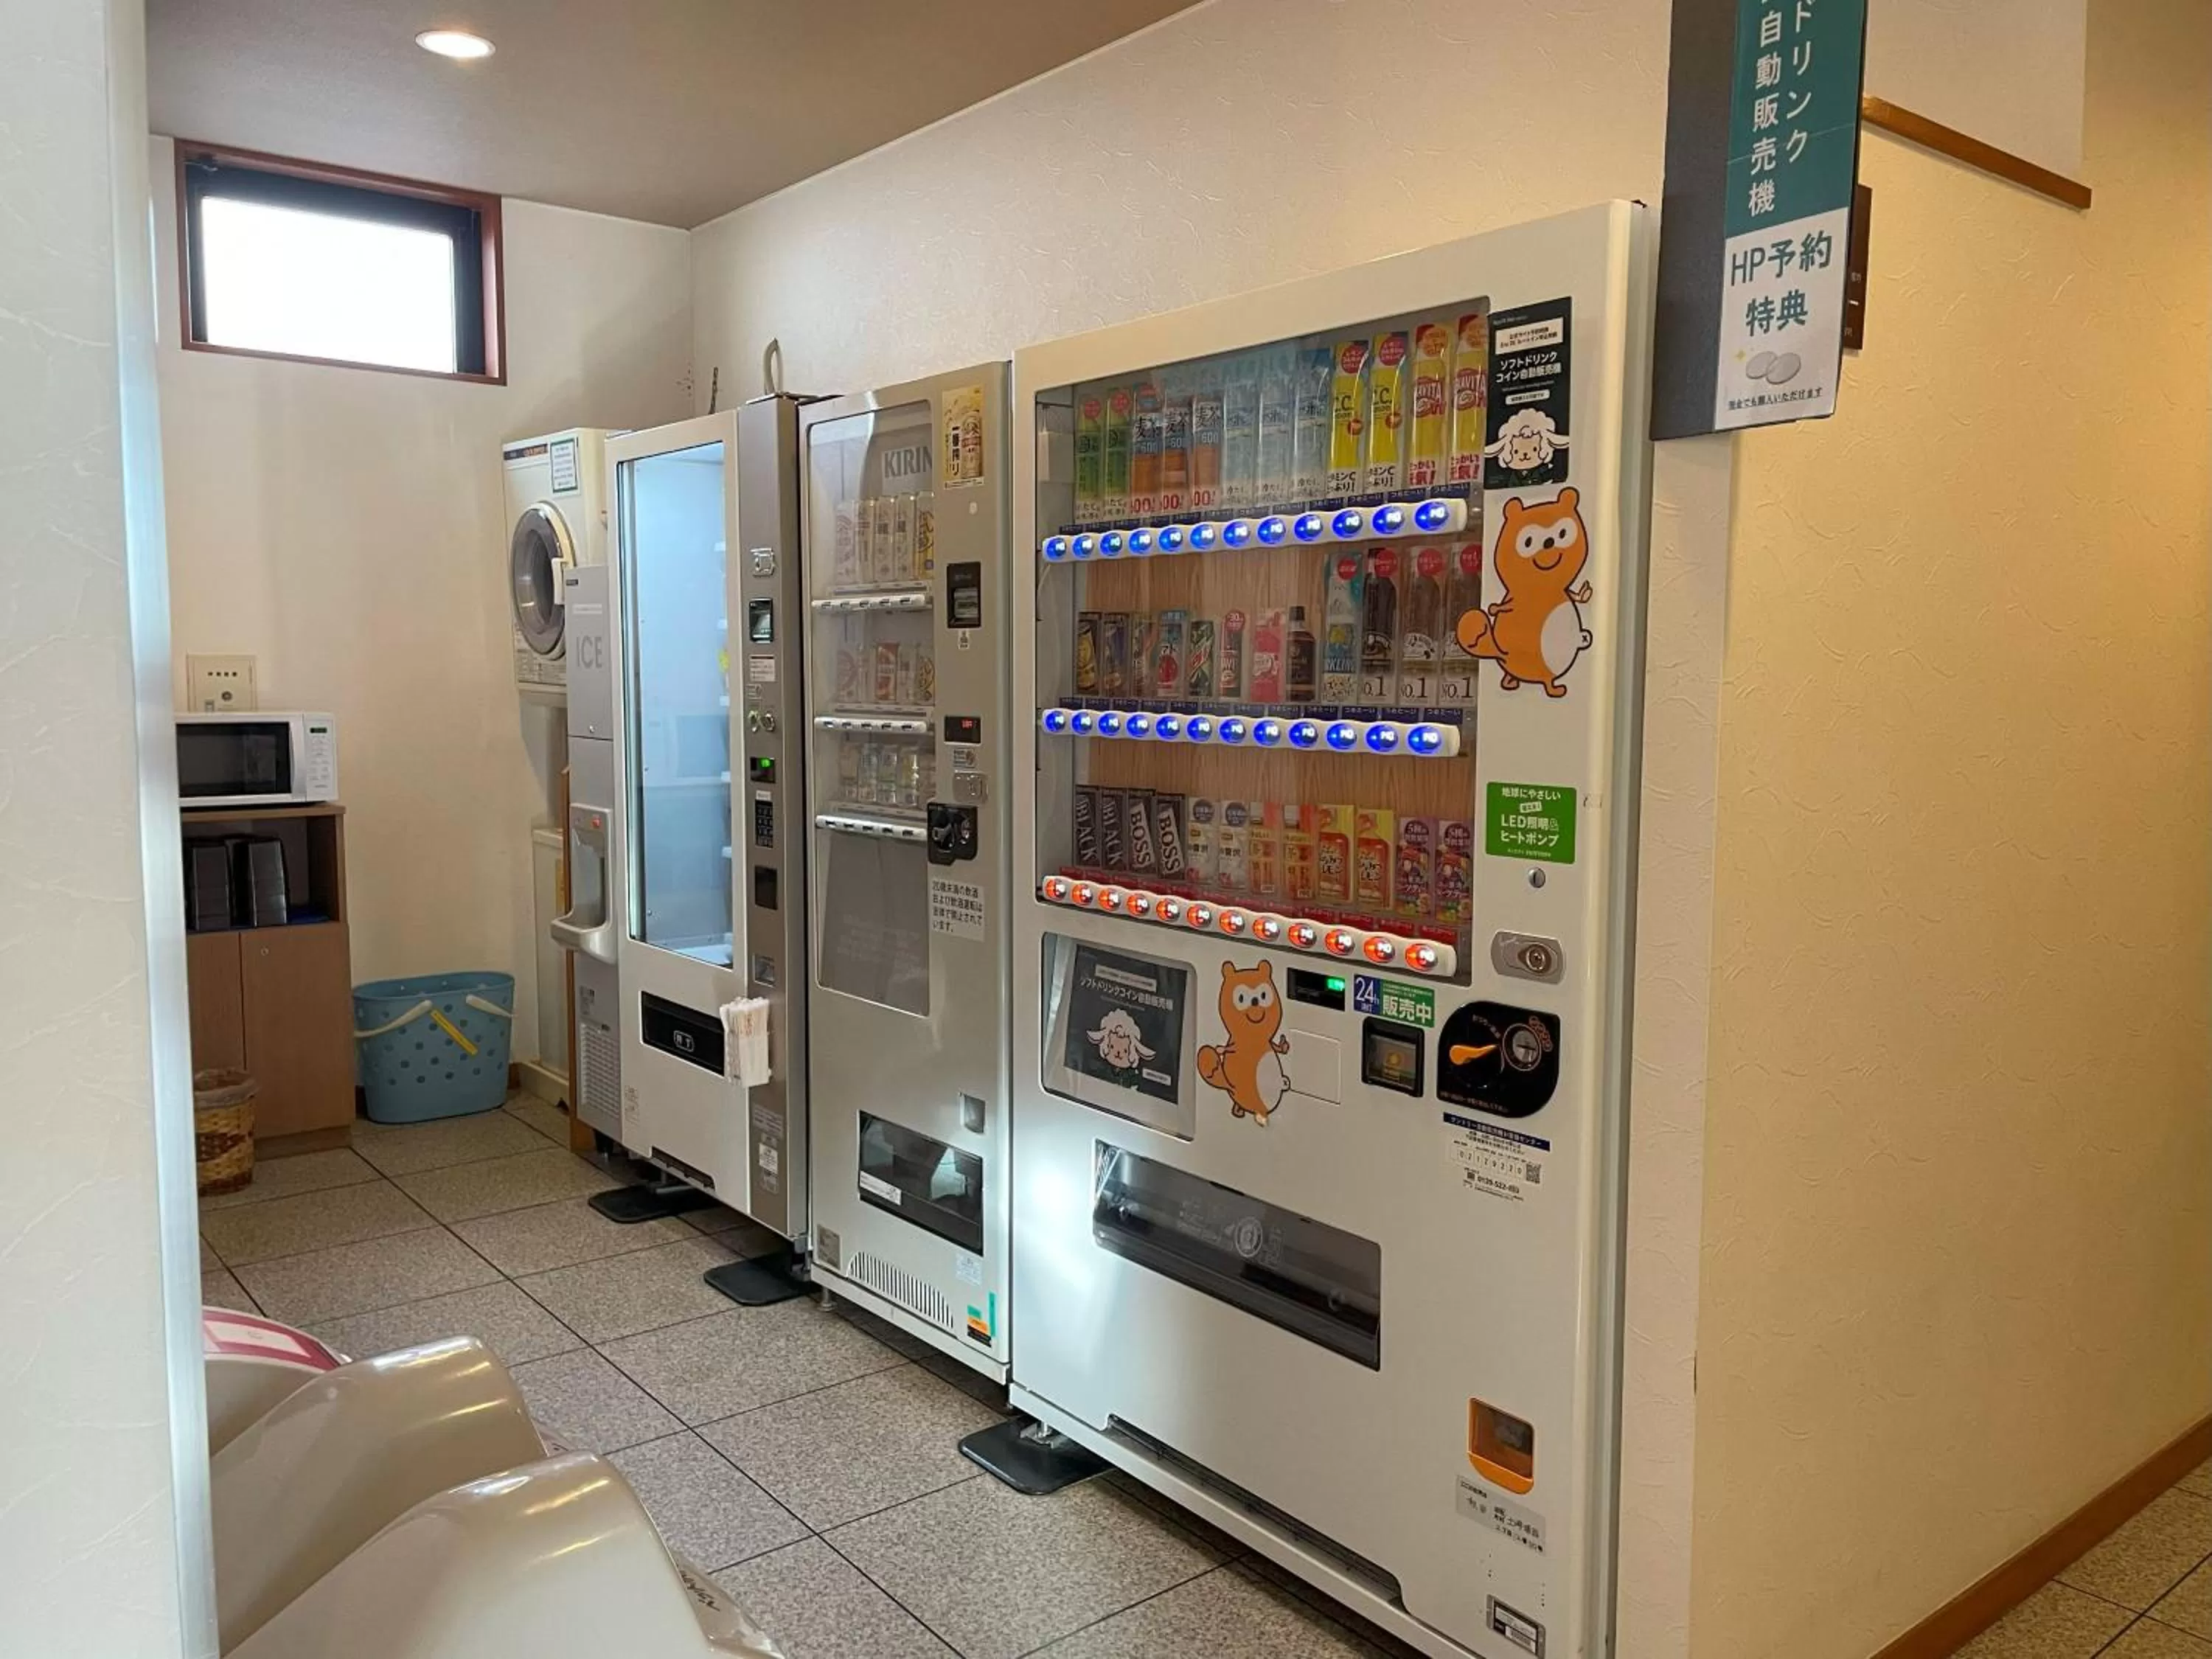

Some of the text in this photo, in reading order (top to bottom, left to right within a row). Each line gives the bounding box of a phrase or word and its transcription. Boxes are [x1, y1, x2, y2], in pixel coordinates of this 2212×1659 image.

[1786, 0, 1815, 163] ドリンク
[1748, 0, 1782, 218] 自動販売機
[1731, 229, 1832, 286] HP予約
[1745, 289, 1809, 338] 特典
[1500, 351, 1558, 370] ソフトドリンク
[884, 446, 932, 479] KIRIN
[576, 635, 602, 669] ICE
[1502, 786, 1561, 800] 地球にやさしい
[1076, 801, 1097, 861] BLACK
[1102, 804, 1124, 866] BLACK
[1130, 810, 1151, 866] BOSS
[1158, 815, 1180, 872] BOSS
[1500, 830, 1559, 847] ヒートポンプ
[1382, 994, 1432, 1024] 販売中
